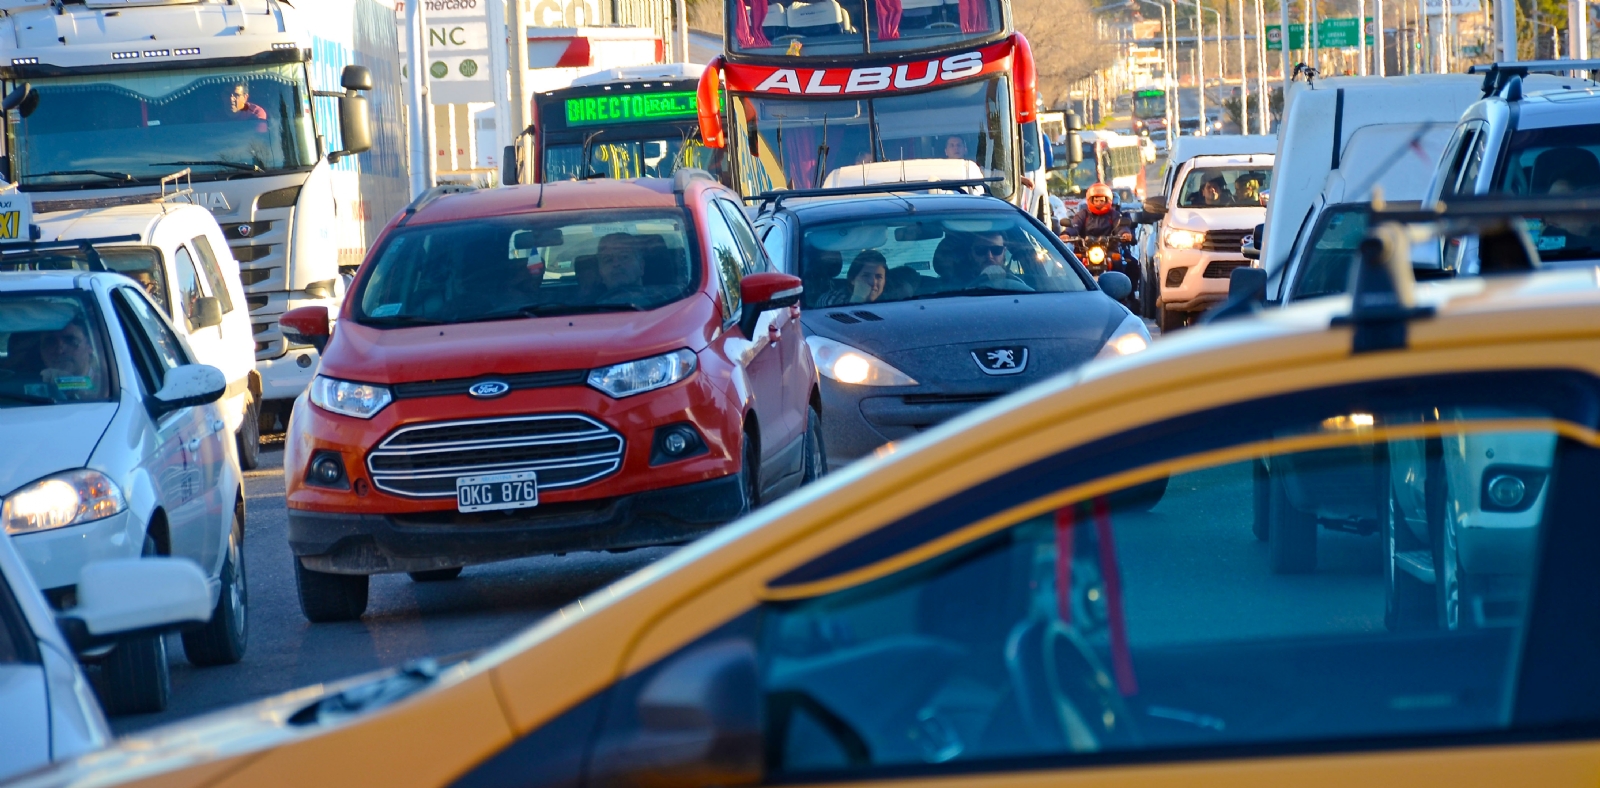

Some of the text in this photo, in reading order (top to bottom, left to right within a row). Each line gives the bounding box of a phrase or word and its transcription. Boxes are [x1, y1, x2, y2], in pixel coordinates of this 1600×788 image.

[755, 51, 983, 94] ALBUS
[568, 95, 643, 121] DIRECTO
[478, 384, 498, 394] Ford
[460, 481, 534, 505] OKG 876
